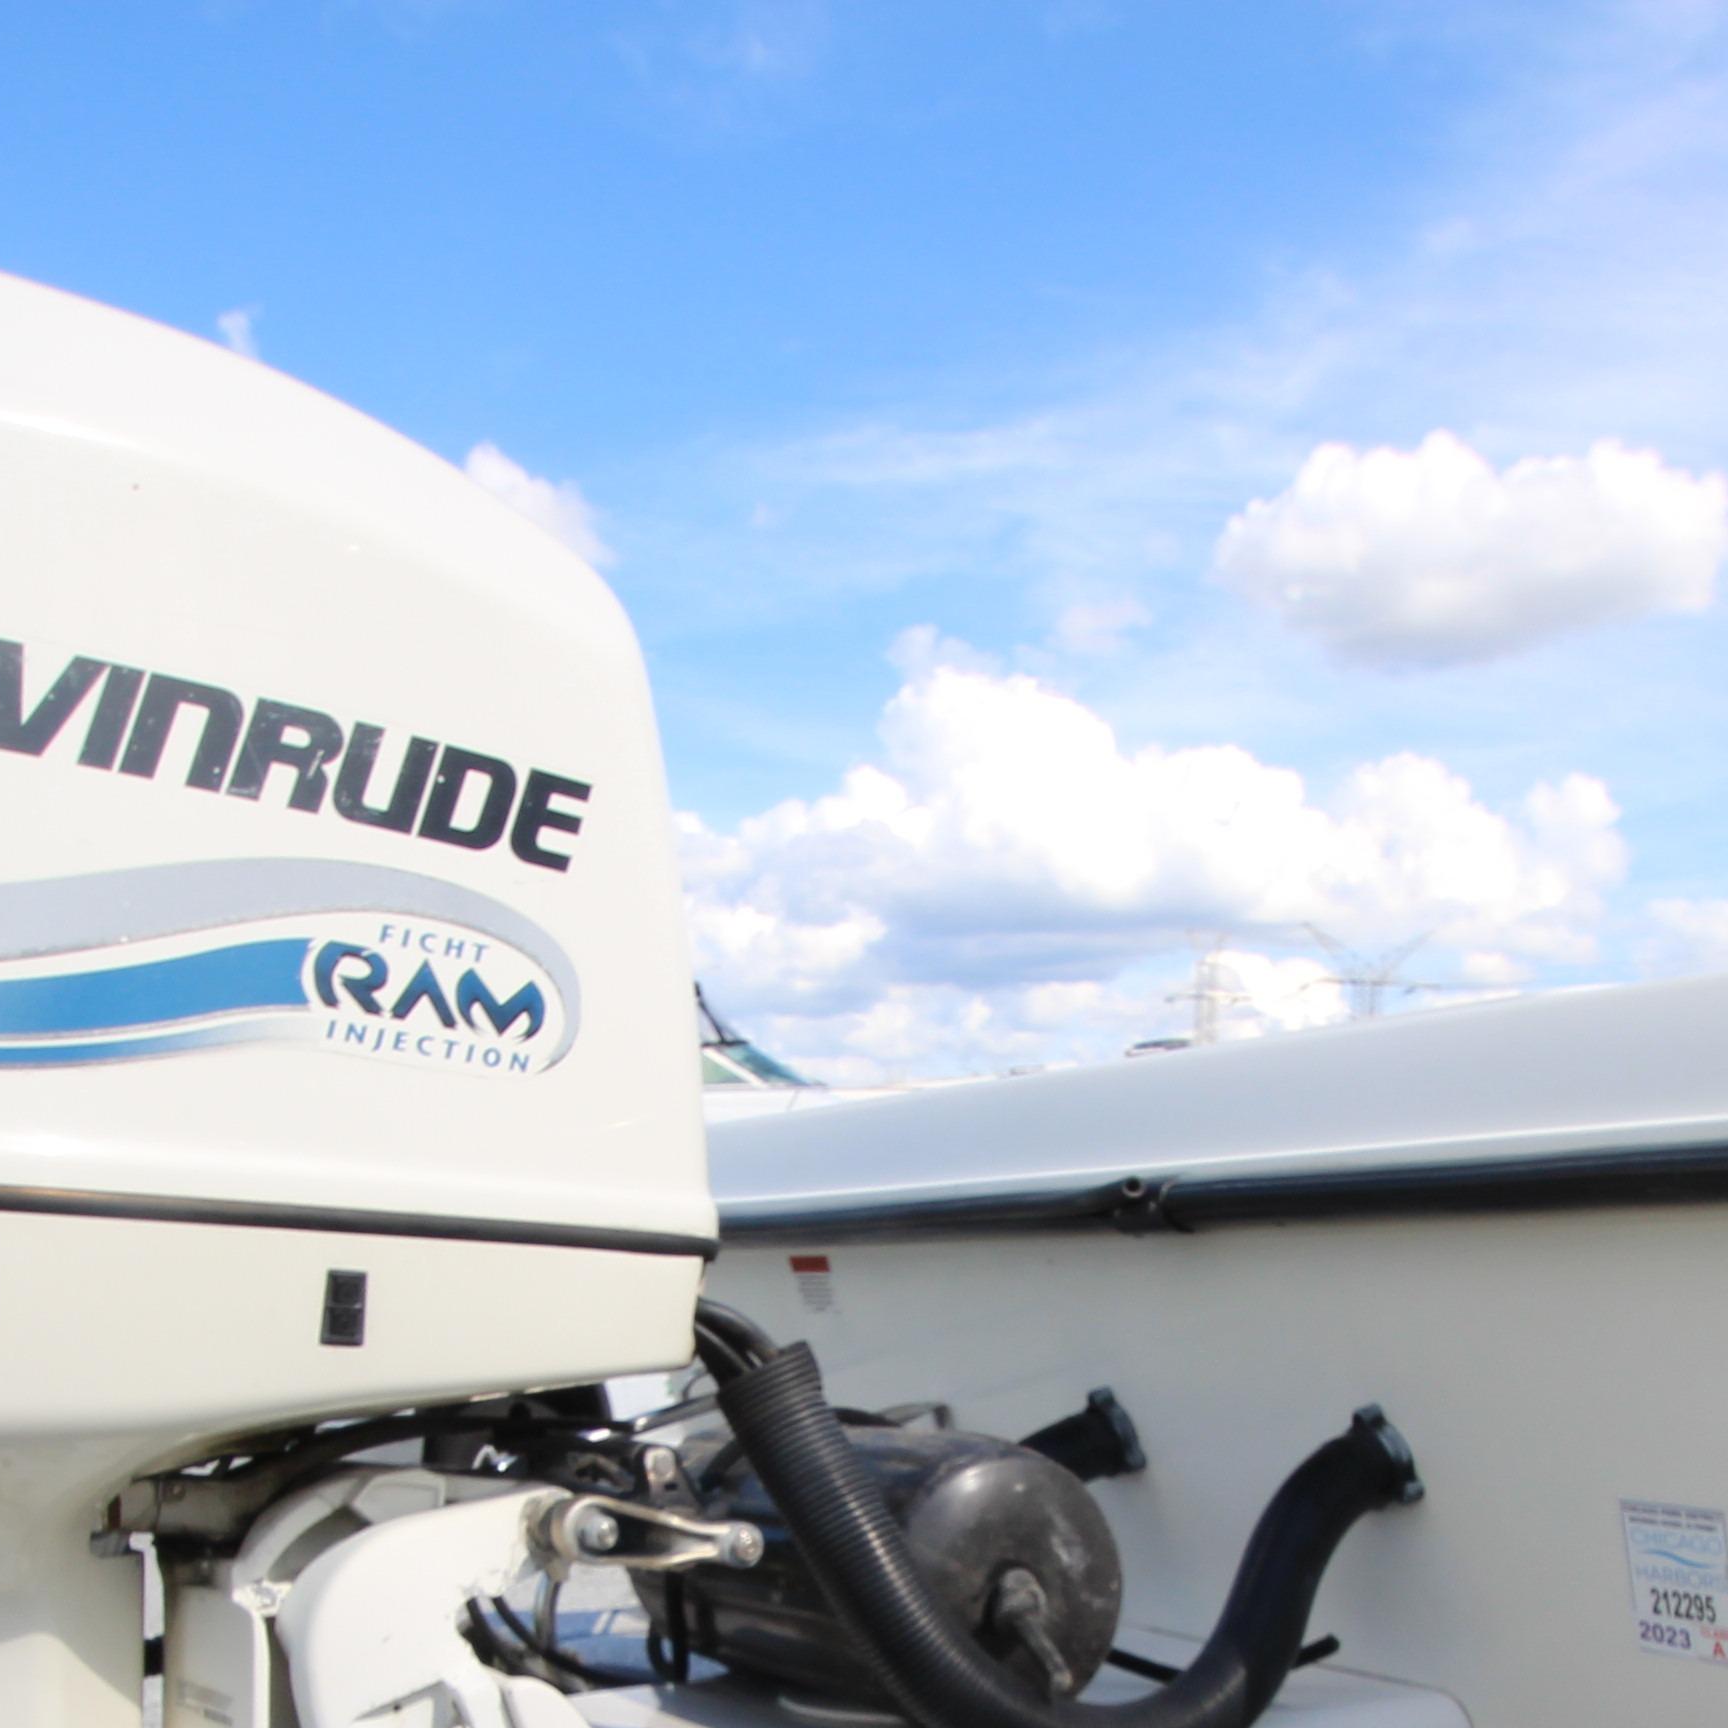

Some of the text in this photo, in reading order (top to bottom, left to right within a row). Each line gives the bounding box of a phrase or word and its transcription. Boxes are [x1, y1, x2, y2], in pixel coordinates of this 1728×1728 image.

[379, 924, 488, 963] FICHT
[313, 940, 545, 1043] RAM
[326, 1020, 530, 1073] INJECTION
[1650, 1587, 1717, 1625] 212295
[1638, 1619, 1691, 1650] 2023
[1713, 1641, 1728, 1661] A
